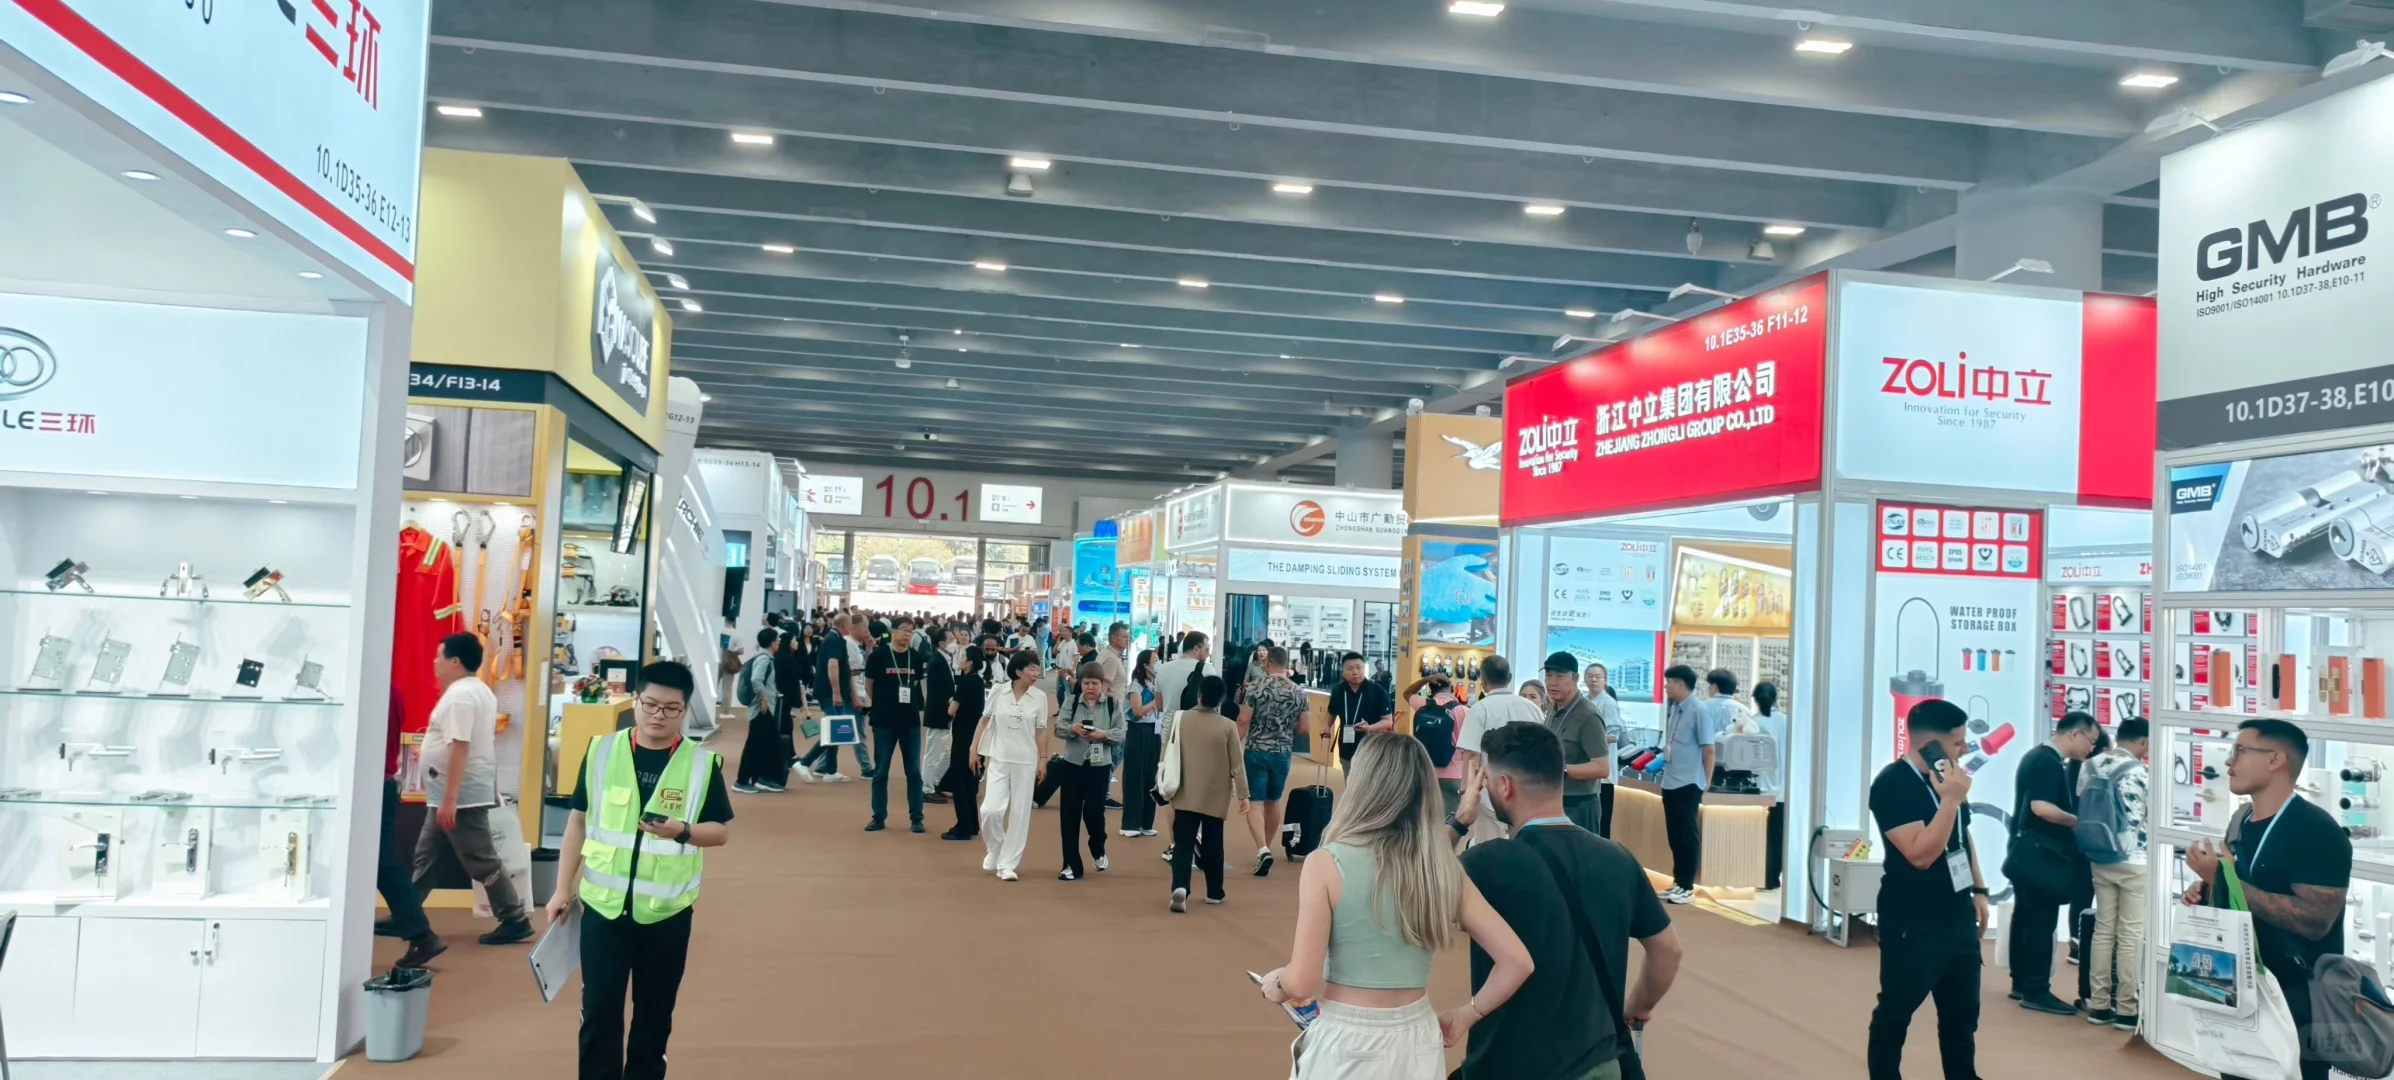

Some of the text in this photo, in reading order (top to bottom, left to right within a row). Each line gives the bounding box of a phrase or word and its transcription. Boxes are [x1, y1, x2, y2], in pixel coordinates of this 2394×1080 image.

[316, 143, 411, 243] 10.1D35-36 E12-13
[2196, 192, 2369, 282] GMB
[2196, 255, 2366, 304] High Security Hardware
[2196, 271, 2365, 319] ISO9001/ISO14001 10.1D37-38,E10-11
[1704, 305, 1808, 352] 10.1E35-36 F11-12
[1596, 360, 1776, 436] 浙江中立集团有限公司
[666, 412, 695, 424] G12-13
[1904, 402, 2027, 423] Innovation for Security
[1595, 405, 1775, 458] ZHEJIANG ZHONGLI GROUP CO.,LTD
[1937, 416, 1997, 429] Since 1987
[1533, 461, 1562, 478] Since 1987
[876, 474, 971, 522] 10.1
[2176, 485, 2212, 500] GMB
[1335, 524, 1373, 533] ZHONGSHAN
[1268, 562, 1397, 578] THE DAMPING SLIDING SYSTEM
[2176, 563, 2207, 572] ISO14001
[1950, 606, 2017, 619] WATER PROOF
[1950, 619, 2017, 632] STORAGE BOX
